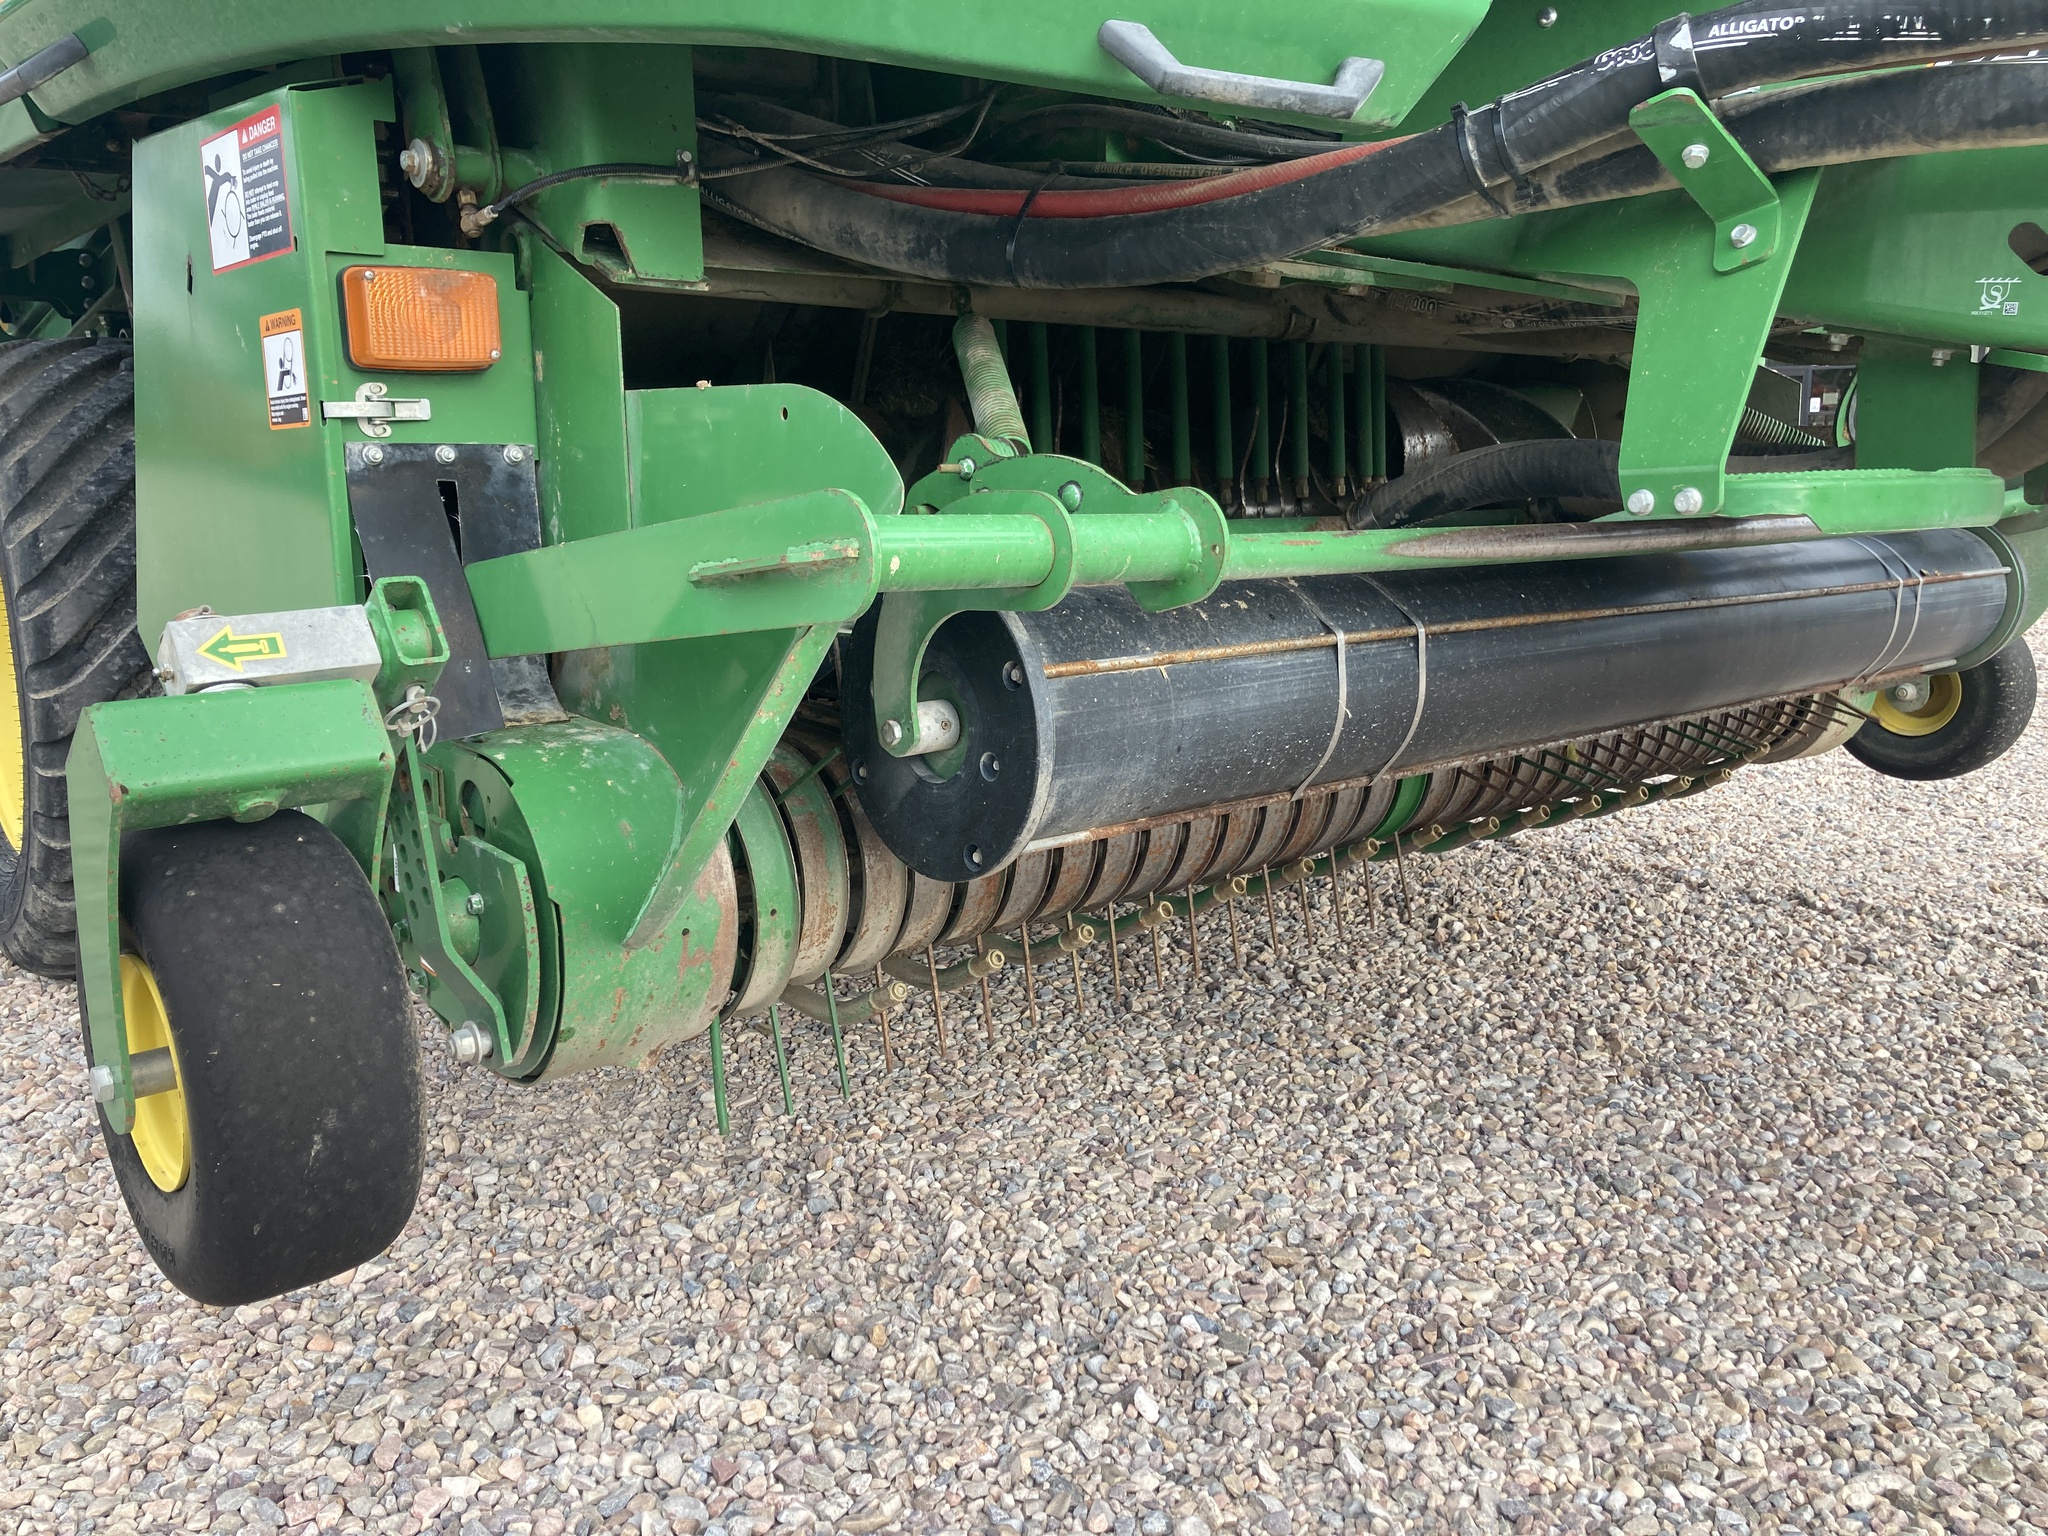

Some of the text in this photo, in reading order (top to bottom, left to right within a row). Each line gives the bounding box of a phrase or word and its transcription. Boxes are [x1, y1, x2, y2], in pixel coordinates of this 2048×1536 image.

[249, 116, 276, 140] DANGER
[700, 187, 752, 220] ALLIGATOR
[270, 314, 296, 330] WARNING
